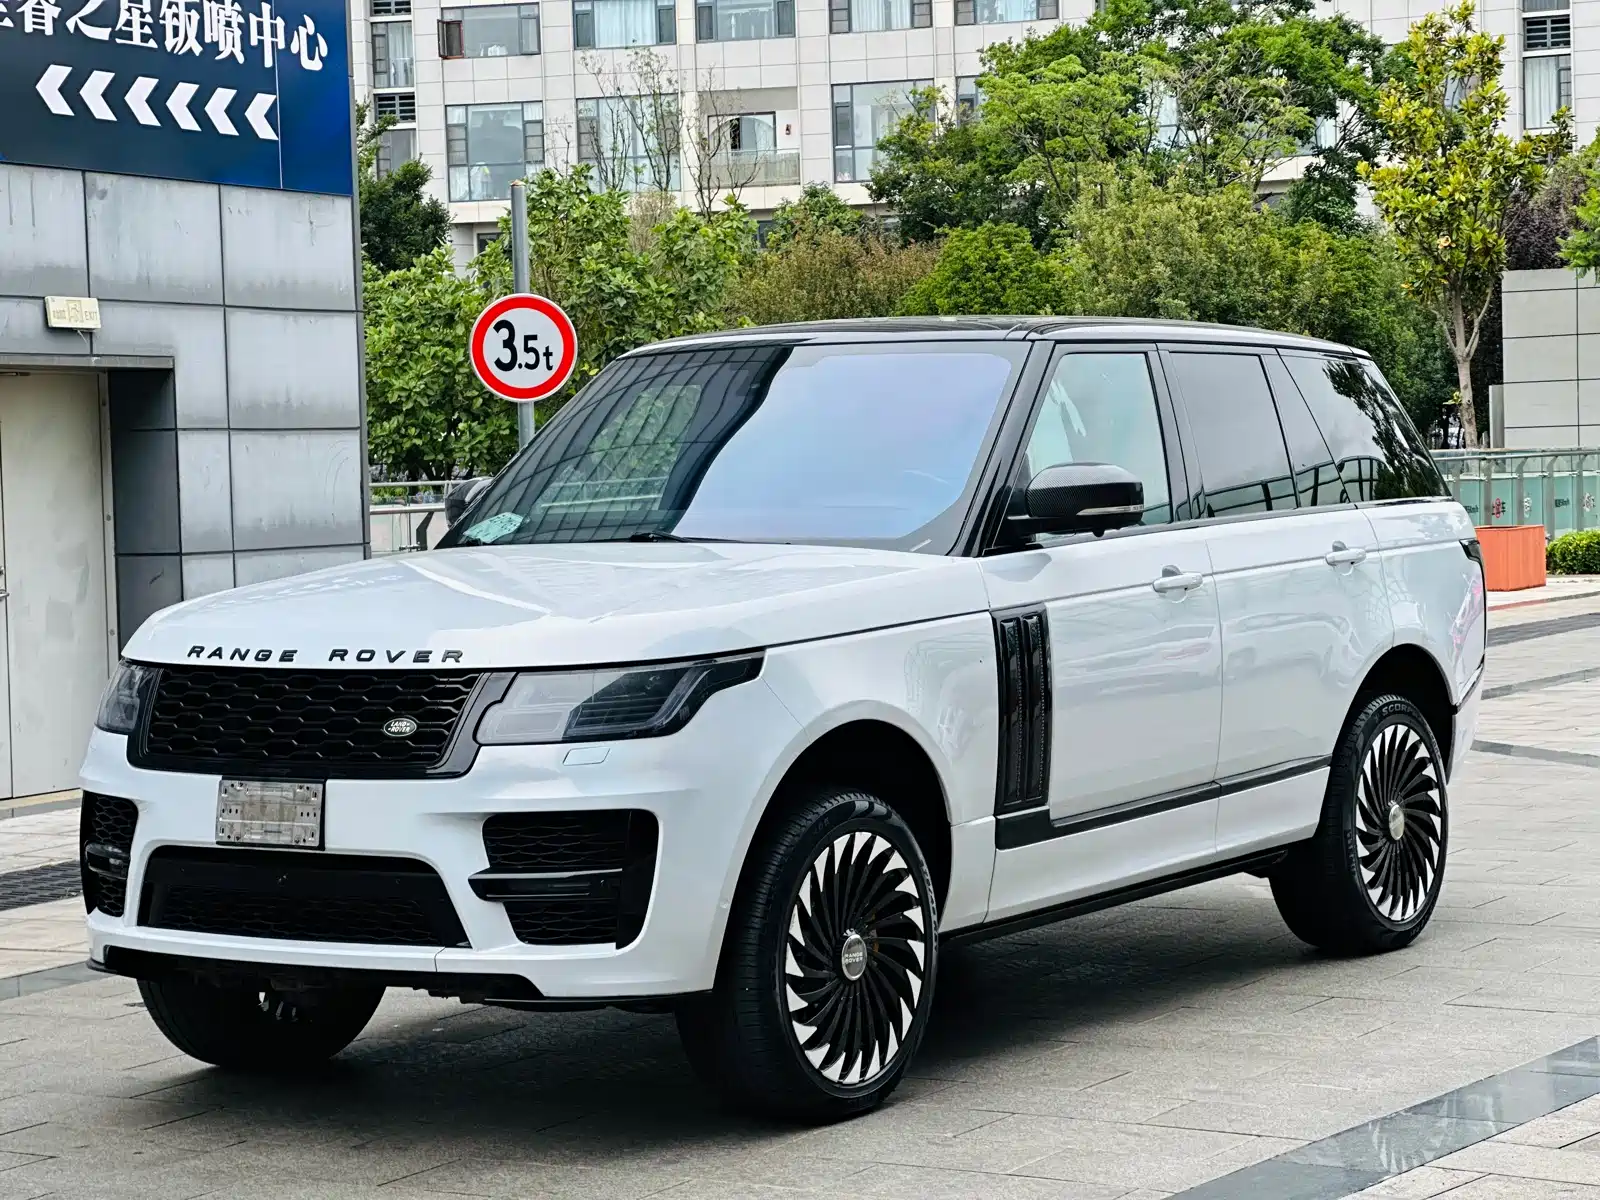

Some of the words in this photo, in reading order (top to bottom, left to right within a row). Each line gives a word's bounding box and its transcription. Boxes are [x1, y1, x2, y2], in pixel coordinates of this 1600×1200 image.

[84, 310, 98, 321] EXIT
[187, 645, 298, 662] RANGE
[328, 649, 463, 663] ROVER
